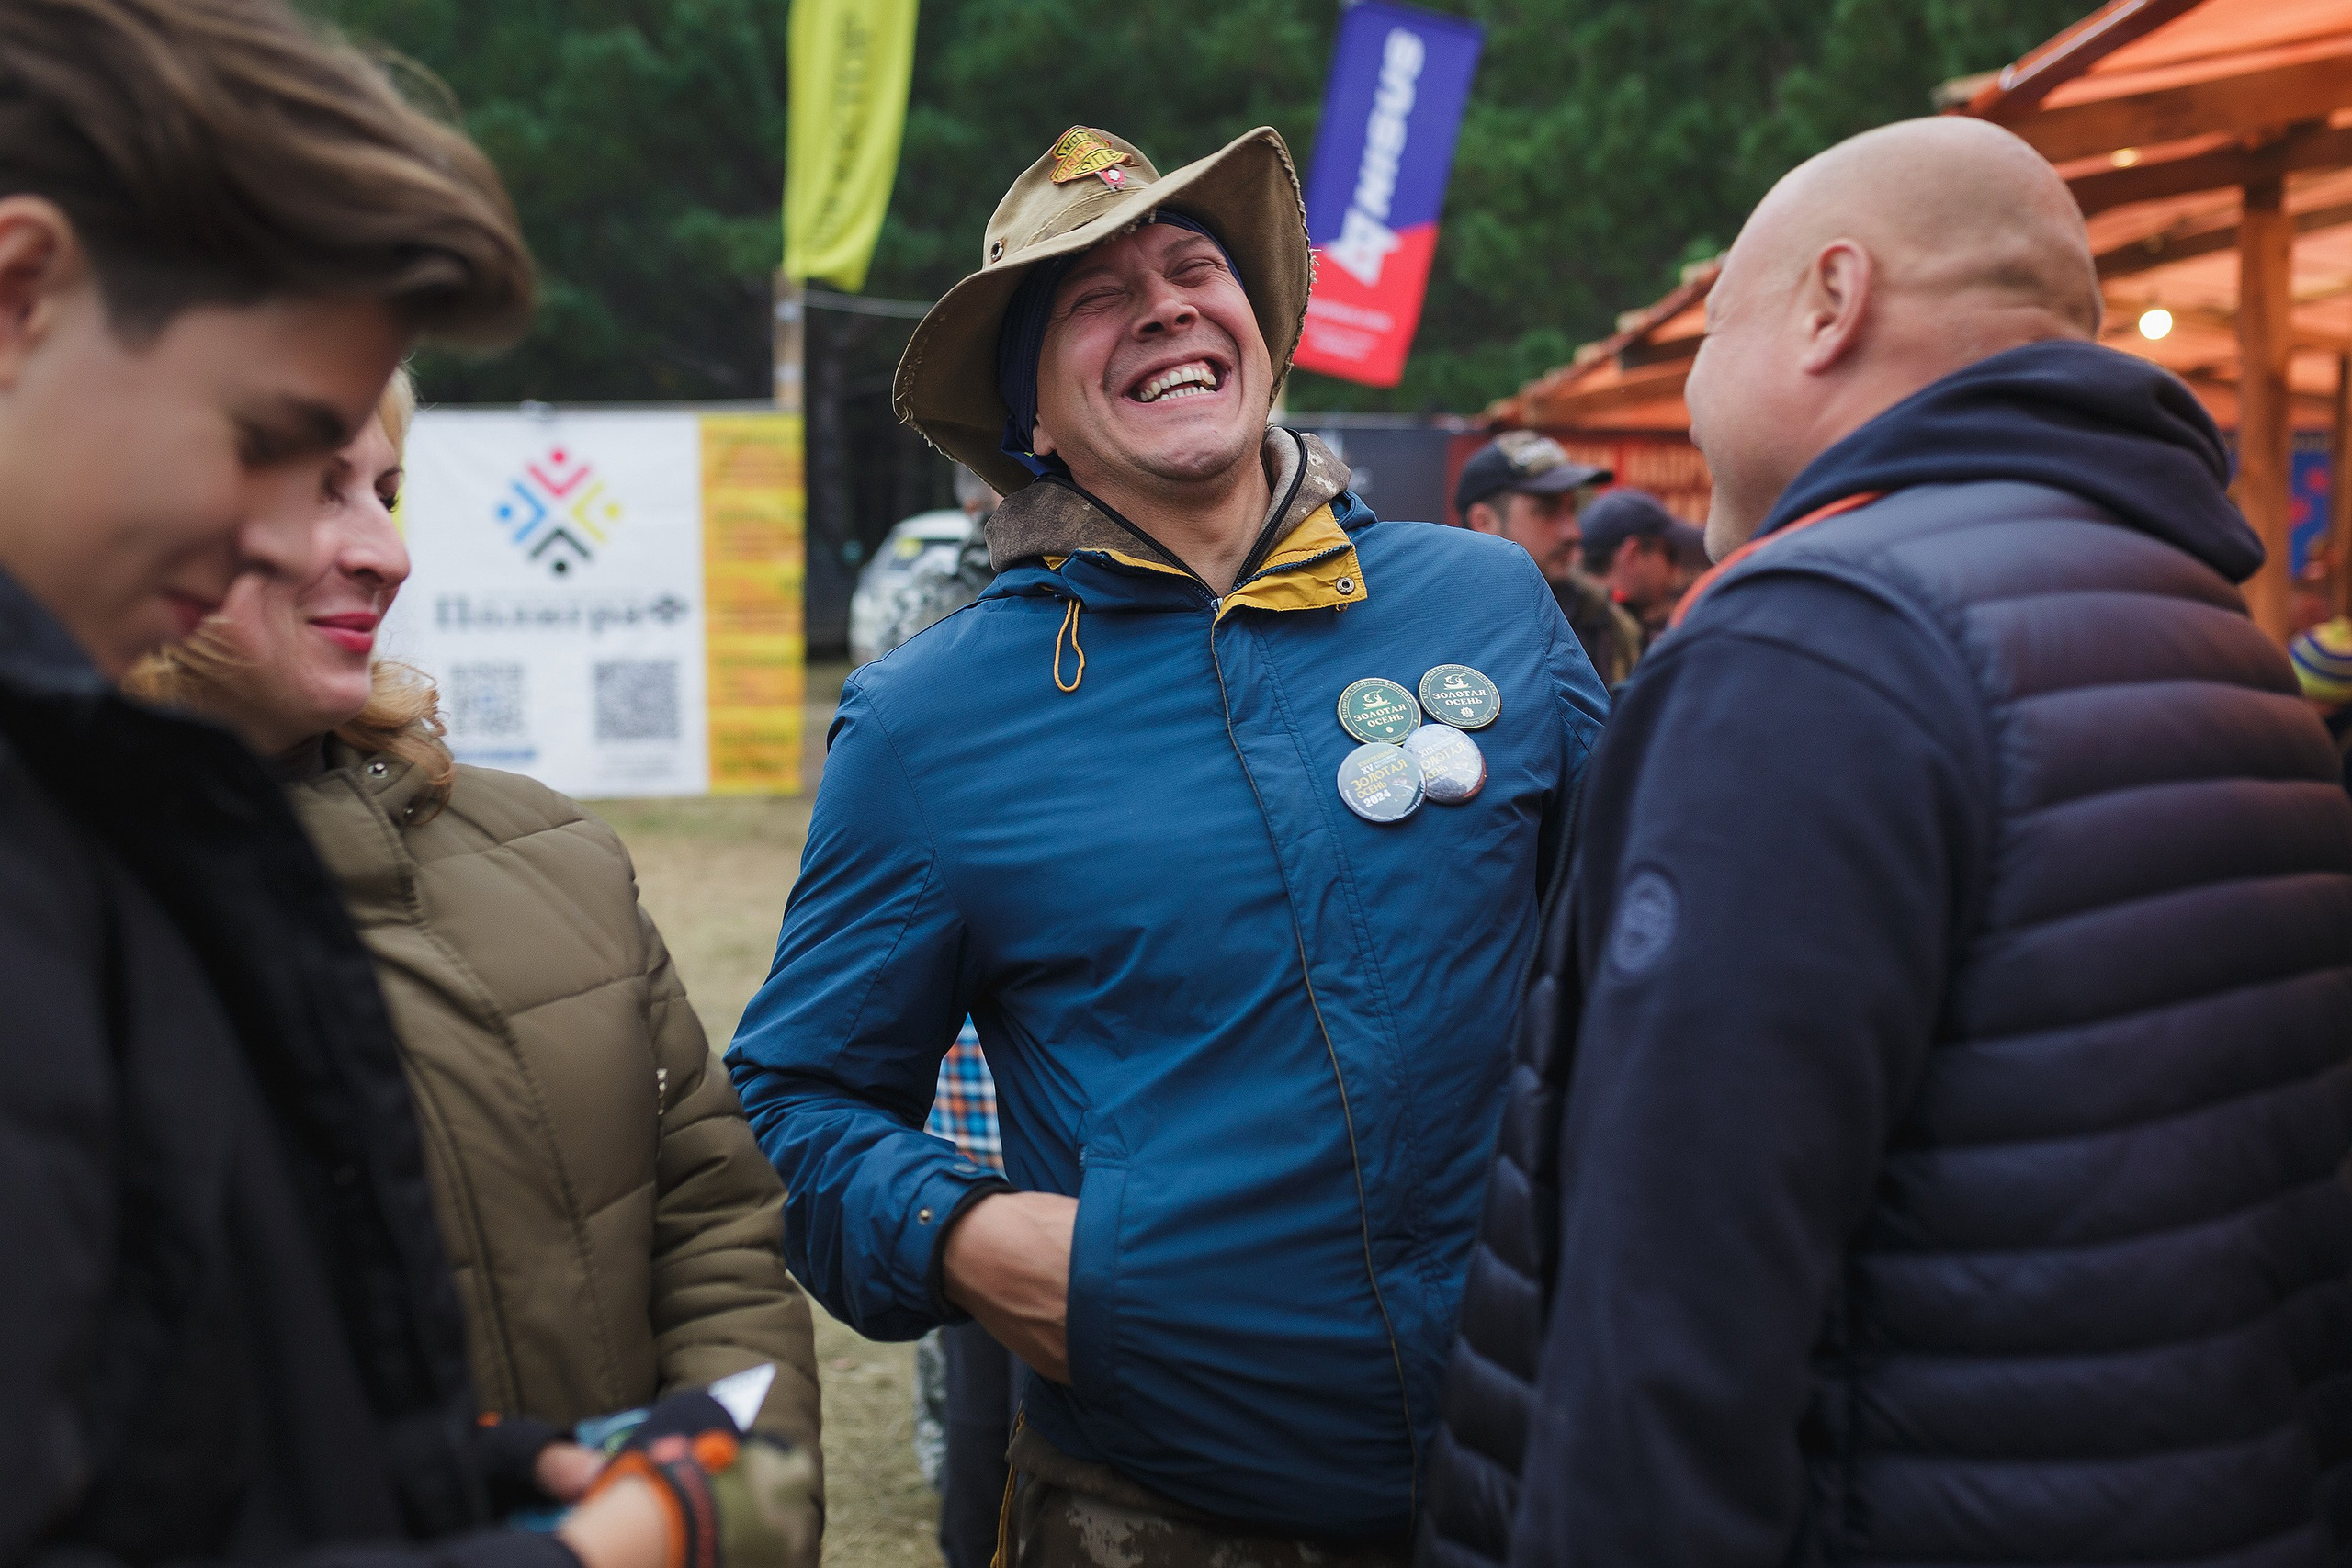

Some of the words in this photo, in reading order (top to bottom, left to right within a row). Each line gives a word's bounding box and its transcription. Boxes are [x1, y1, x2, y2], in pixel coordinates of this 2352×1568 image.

[1432, 689, 1487, 700] ЗОЛОТАЯ
[1445, 697, 1483, 706] ОСЕНЬ
[1353, 704, 1408, 722] ЗОЛОТАЯ
[1367, 714, 1404, 728] ОСЕНЬ
[1418, 746, 1435, 758] XIII
[1420, 741, 1467, 770] ОЛОТАЯ
[1351, 759, 1408, 791] ЗОЛОТАЯ
[1360, 764, 1374, 775] XV
[1425, 764, 1449, 780] СЕНЬ
[1357, 781, 1387, 799] ОСЕНЬ
[1363, 789, 1392, 808] 2024
